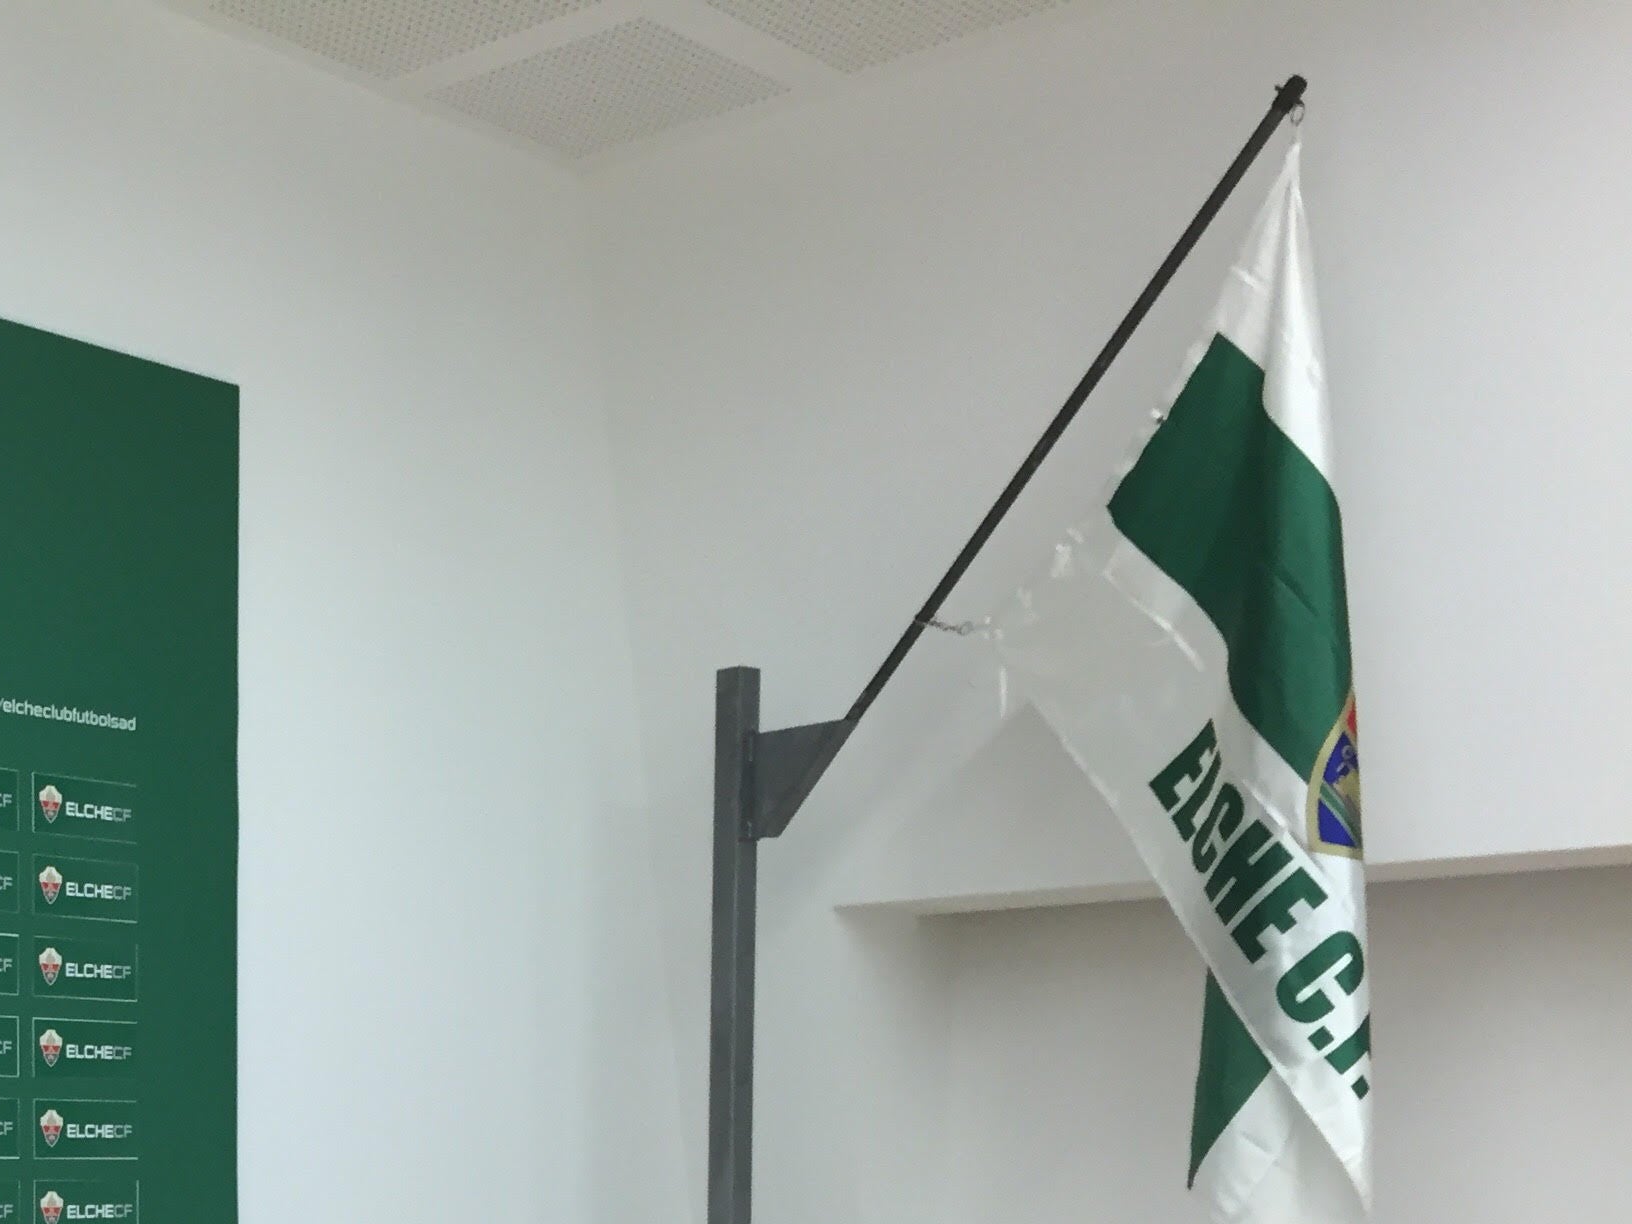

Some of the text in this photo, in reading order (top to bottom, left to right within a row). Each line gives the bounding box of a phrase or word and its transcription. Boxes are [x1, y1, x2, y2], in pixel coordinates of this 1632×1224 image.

[65, 801, 131, 823] ELCHECF
[1148, 717, 1328, 965] ELCHE
[65, 881, 131, 901] ELCHECF
[65, 963, 131, 979] ELCHECF
[66, 1045, 132, 1060] ELCHECF
[66, 1124, 132, 1139] ELCHECF
[66, 1204, 132, 1219] ELCHECF
